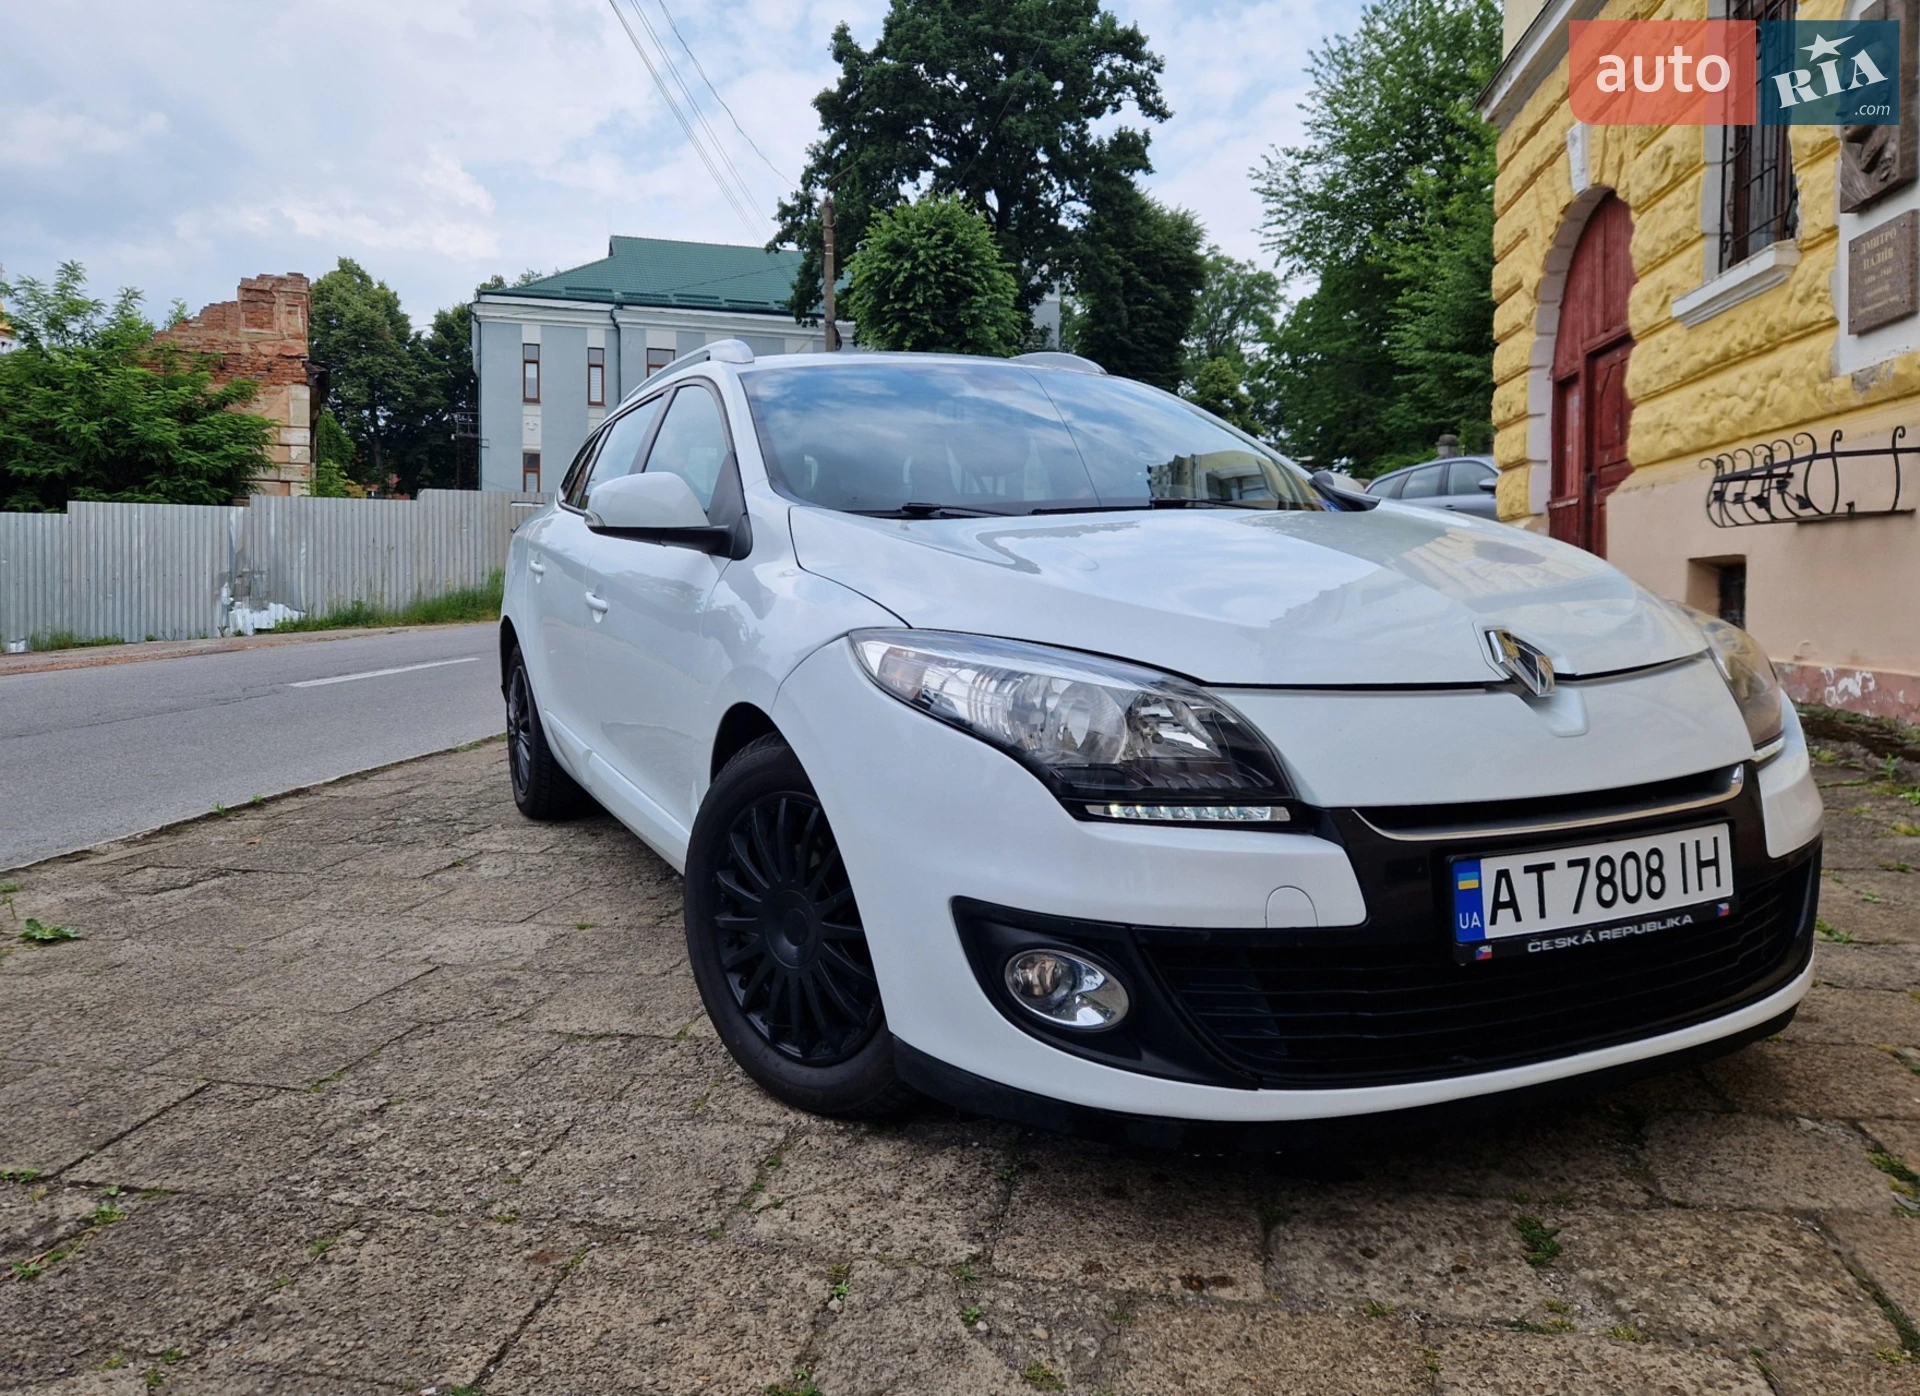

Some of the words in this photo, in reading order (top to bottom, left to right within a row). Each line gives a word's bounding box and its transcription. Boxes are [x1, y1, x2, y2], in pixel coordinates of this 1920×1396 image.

[1489, 862, 1556, 926] AT
[1567, 847, 1666, 915] 7808
[1680, 836, 1721, 895] IH
[1459, 911, 1482, 930] UA
[1527, 929, 1597, 953] ČESKÁ
[1598, 914, 1694, 942] REPUBLIKA
